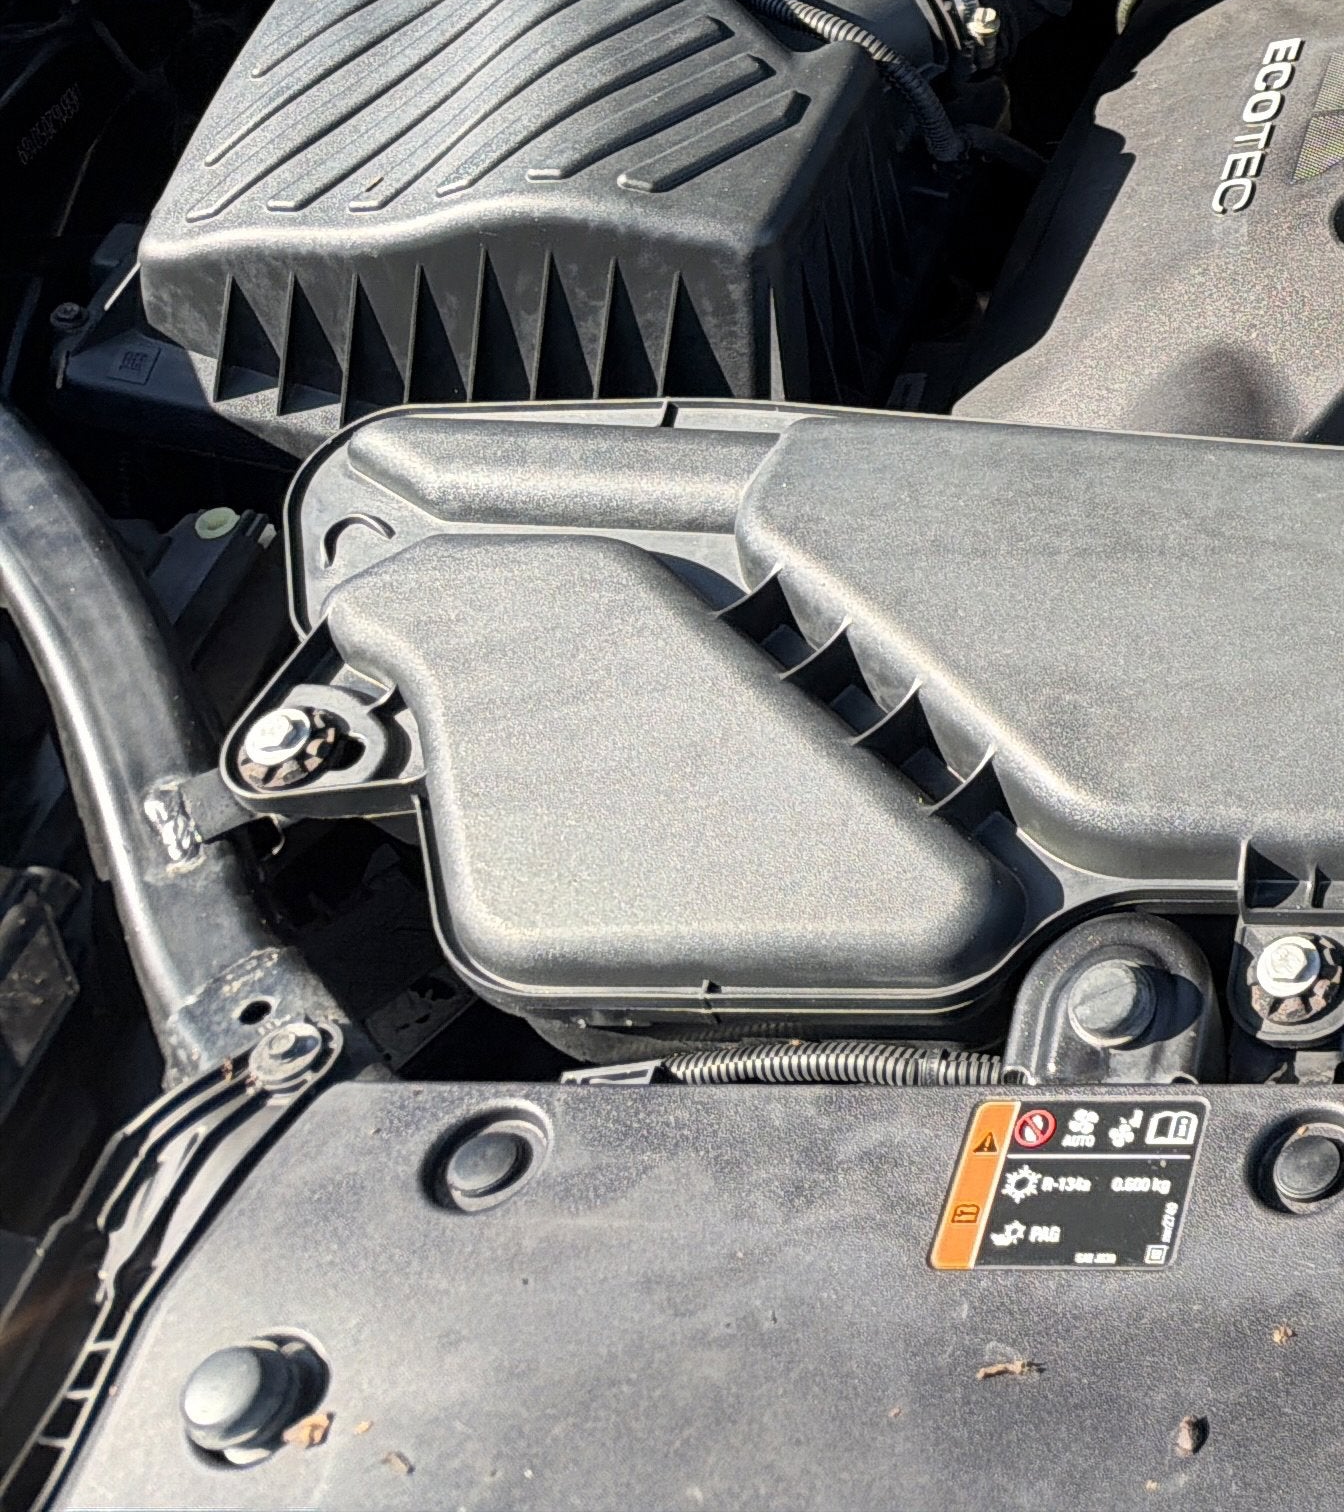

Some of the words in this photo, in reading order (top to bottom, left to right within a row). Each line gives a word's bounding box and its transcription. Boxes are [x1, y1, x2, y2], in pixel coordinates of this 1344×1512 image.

[1211, 36, 1304, 215] ECOTEC
[1062, 1134, 1095, 1148] AUTO
[1041, 1176, 1091, 1193] R-134a
[1151, 1177, 1171, 1195] kg
[1028, 1225, 1061, 1243] PAG
